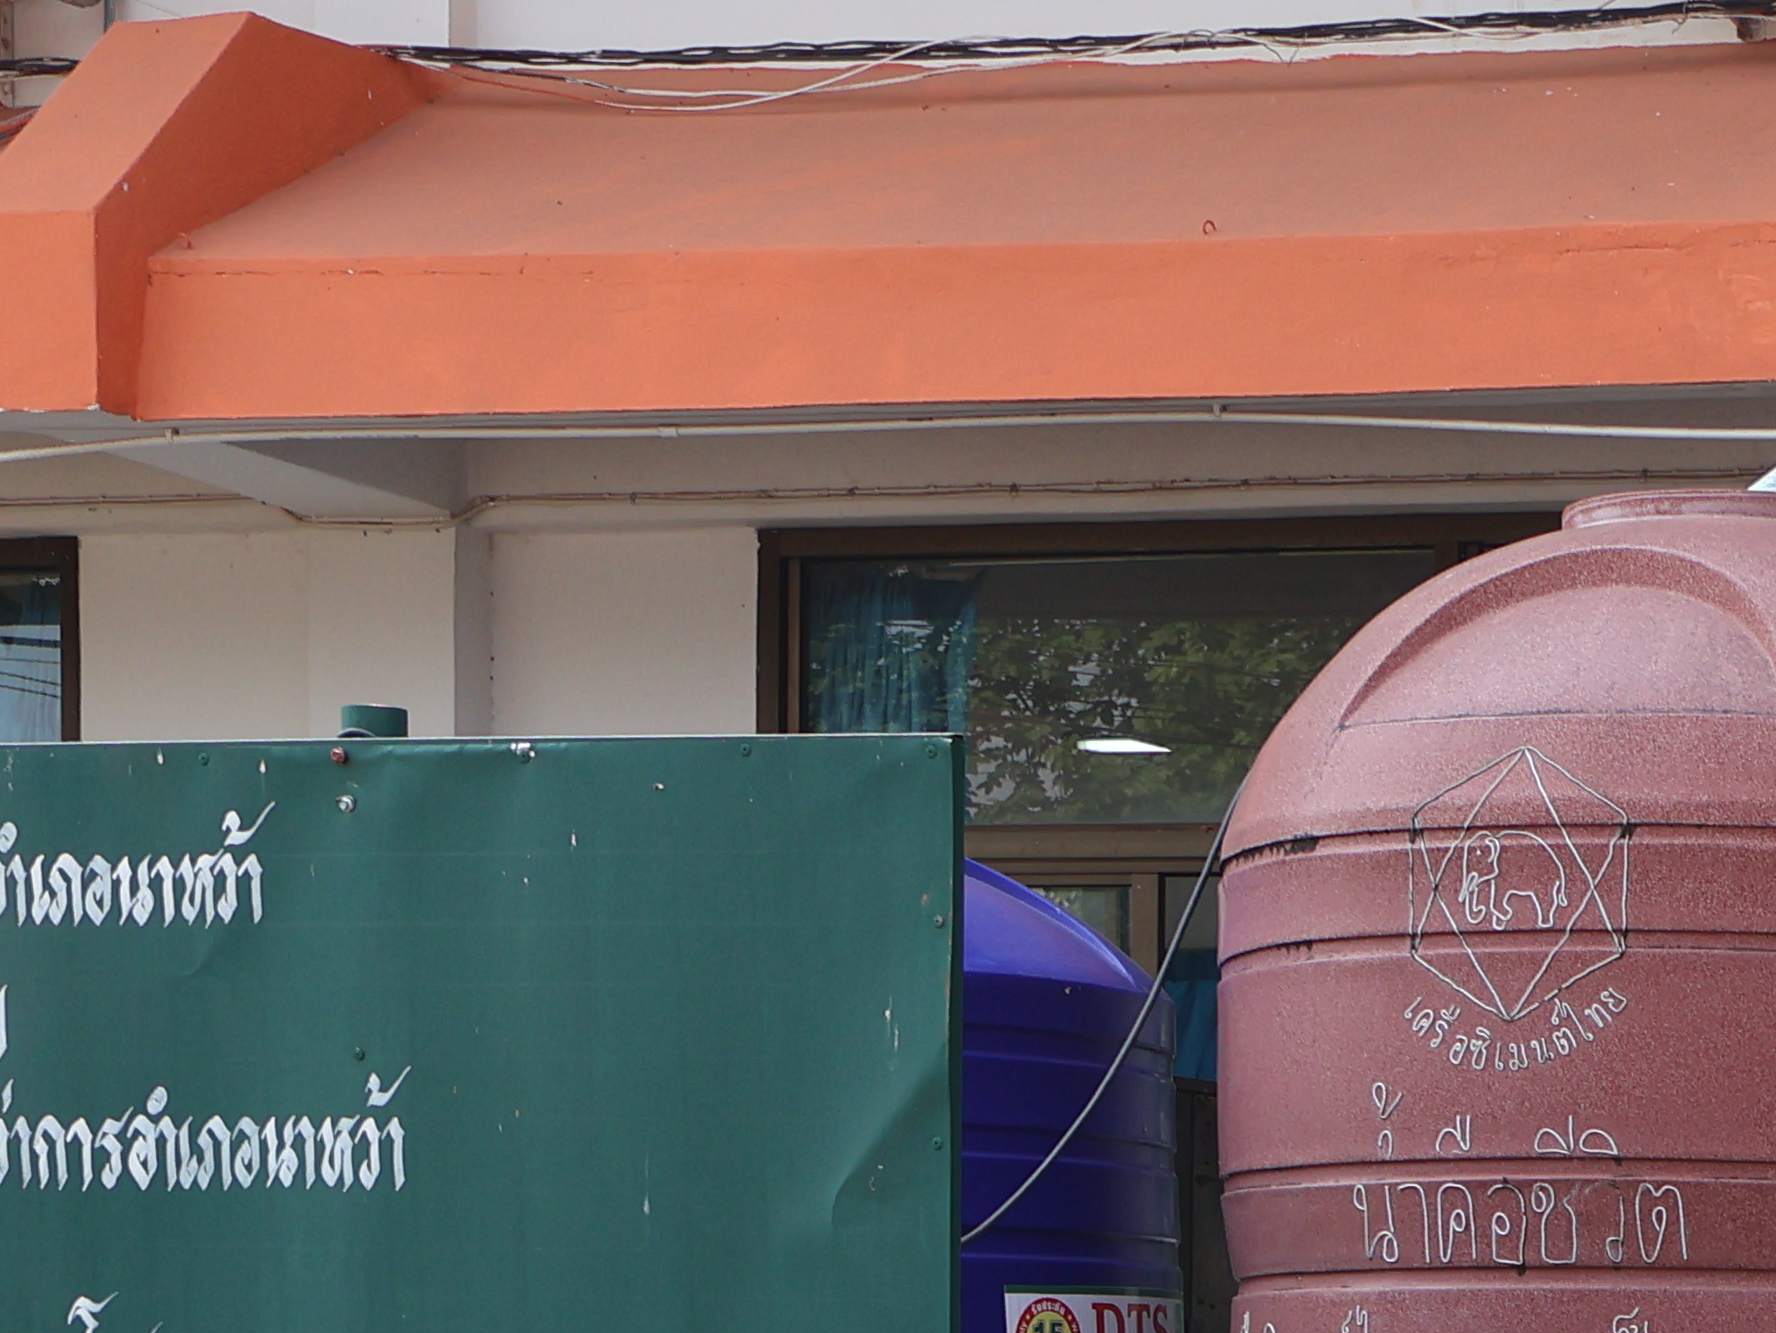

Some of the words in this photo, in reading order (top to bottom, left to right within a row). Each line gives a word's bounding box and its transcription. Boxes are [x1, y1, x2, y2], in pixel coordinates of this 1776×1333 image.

[0, 801, 276, 928] ำเภอนาหว้า
[1354, 1082, 1688, 1266] น้ำคือชีวิต
